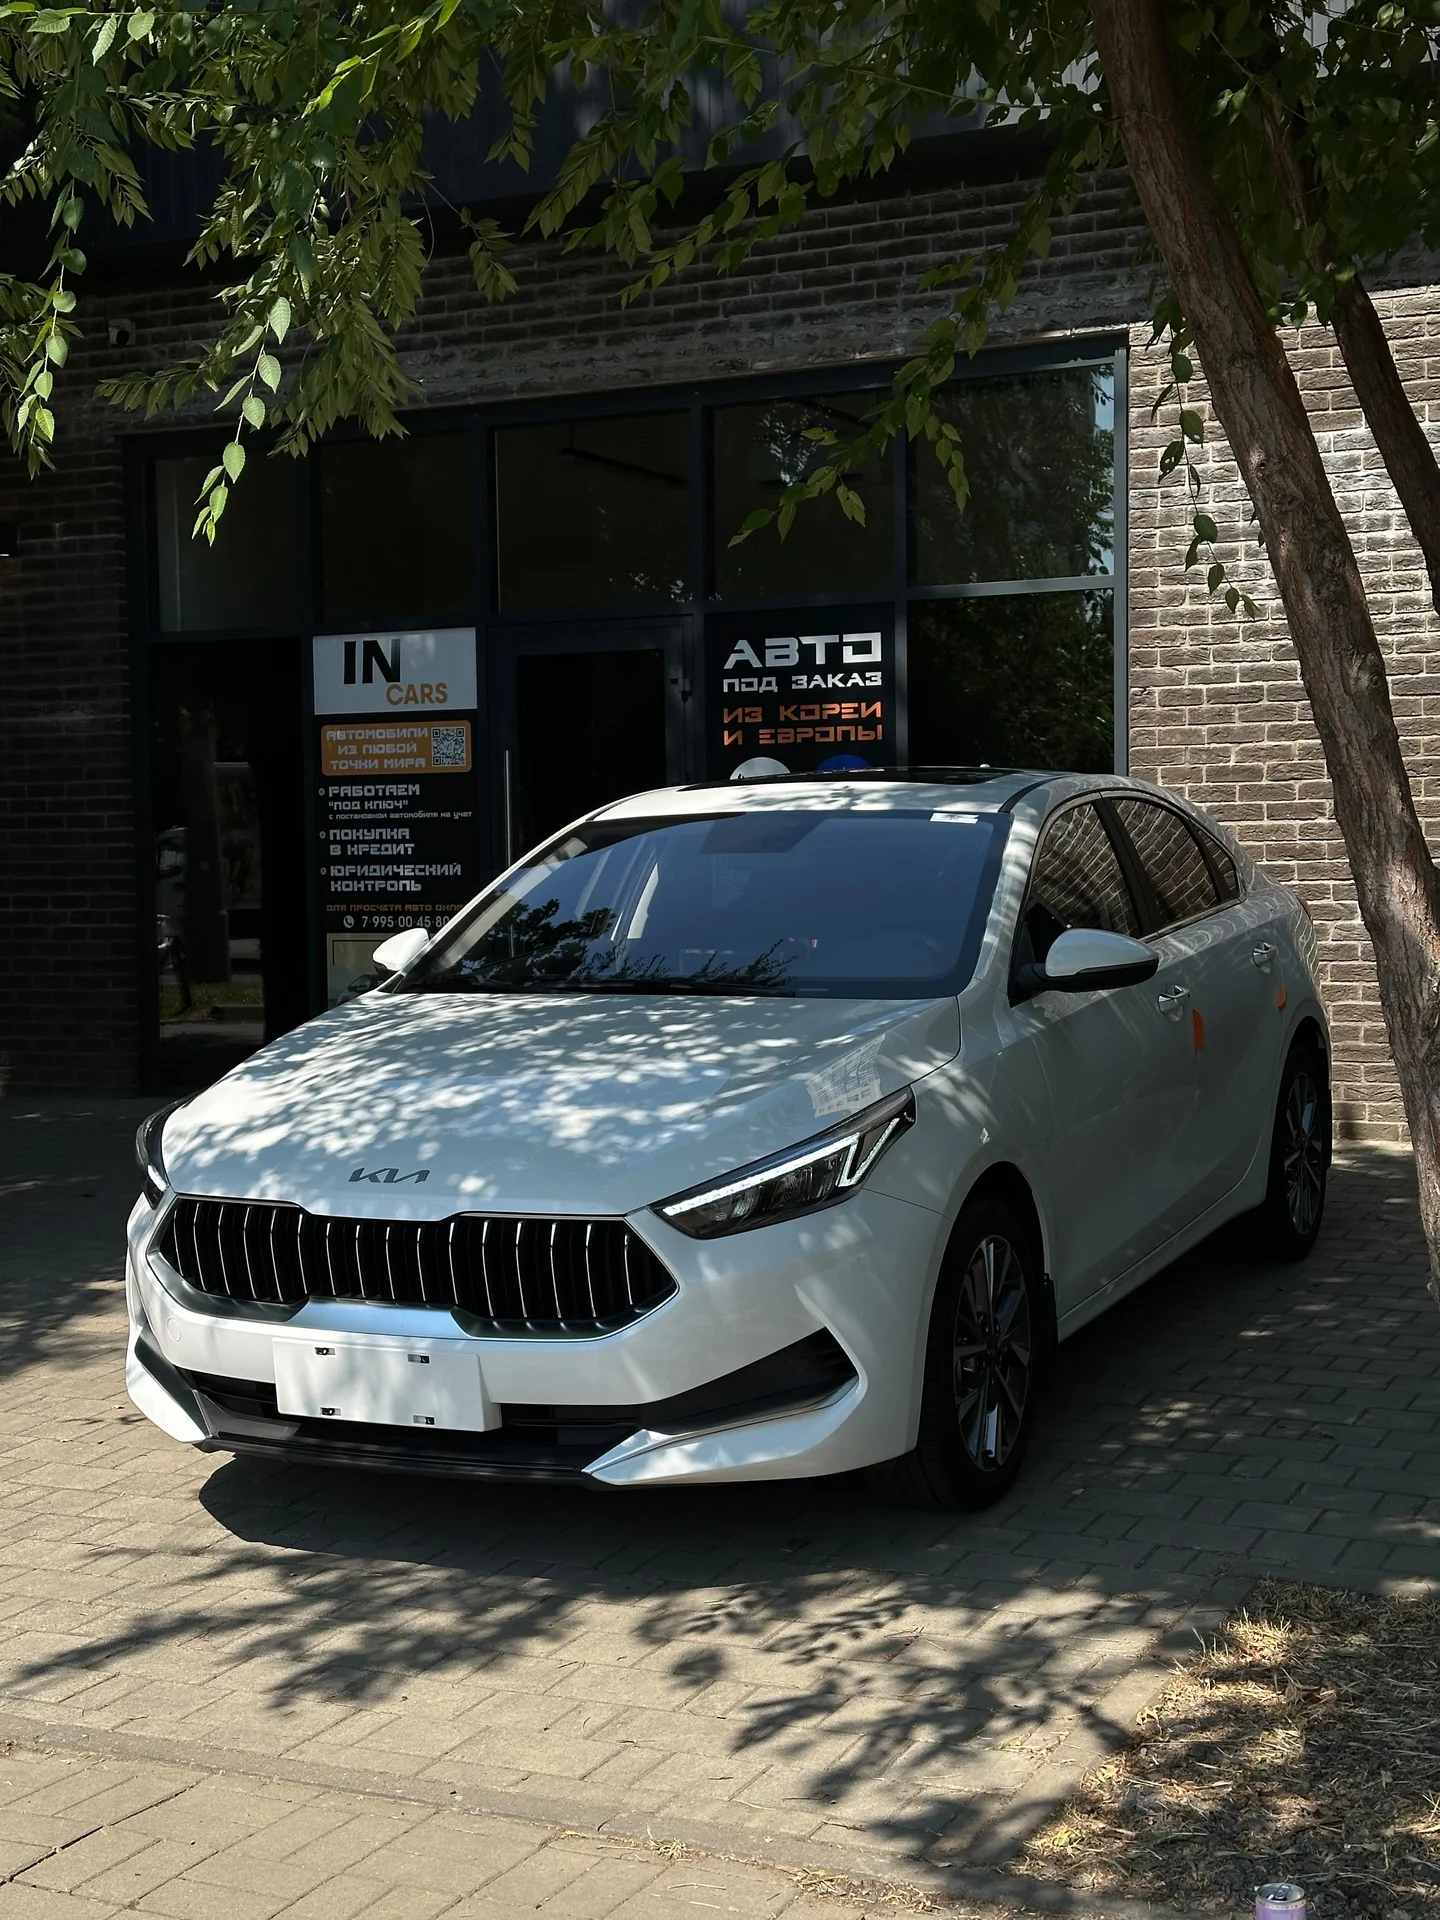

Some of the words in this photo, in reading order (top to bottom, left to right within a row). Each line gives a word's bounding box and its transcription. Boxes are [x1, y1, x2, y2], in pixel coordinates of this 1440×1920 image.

[723, 632, 882, 669] АВТО
[343, 638, 401, 685] IN
[723, 676, 778, 693] ПОД
[791, 671, 882, 689] ЗАКАЗ
[386, 682, 448, 706] CARS
[723, 706, 763, 724] ИЗ
[779, 701, 882, 722] КОРЕИ
[326, 727, 429, 741] АВТОМОБИЛИ
[723, 729, 743, 746] И
[759, 724, 883, 745] ЕВРОПЫ
[338, 745, 357, 756] ИЗ
[362, 741, 417, 755] ЛЮБОЙ
[330, 760, 379, 770] ТОЧКИ
[383, 758, 426, 769] МИРА
[328, 784, 420, 798] РАБОТАЕМ
[329, 828, 410, 841] ПОКУПКА
[329, 844, 342, 856] В
[347, 843, 415, 856] КРЕДИТ
[330, 863, 462, 877] ЮРИДИЧЕСКИЙ
[330, 880, 422, 892] КОНТРОЛЬ
[350, 904, 402, 912] ПРОСЧЕТА
[435, 904, 464, 912] ОНЛА
